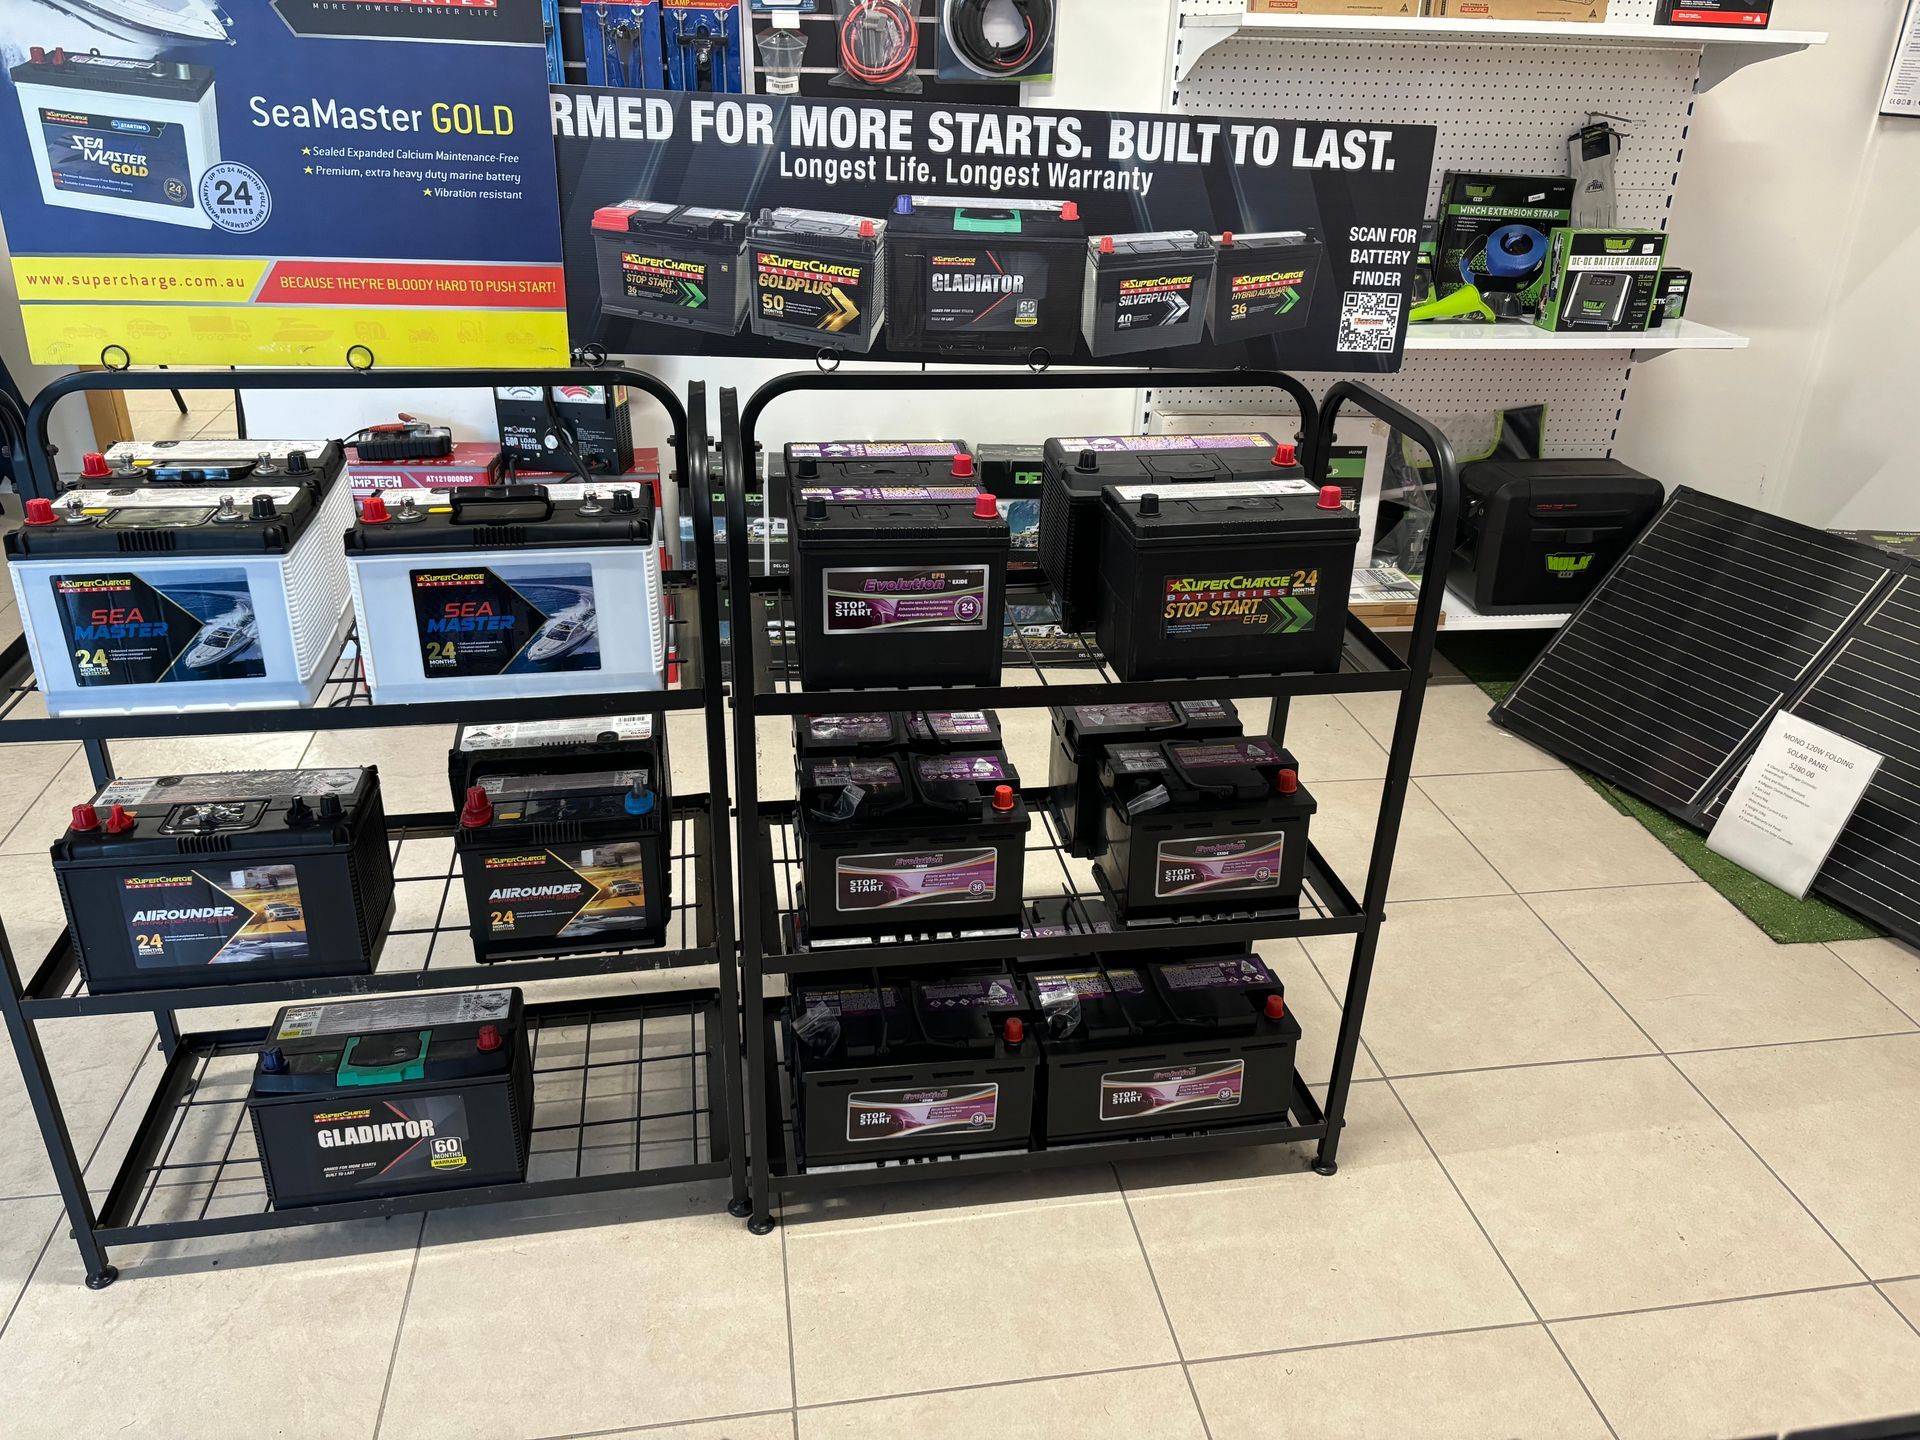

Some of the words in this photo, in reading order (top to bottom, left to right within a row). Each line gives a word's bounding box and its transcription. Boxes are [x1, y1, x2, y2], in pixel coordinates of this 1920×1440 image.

[312, 2, 347, 11] MORE
[356, 4, 405, 13] POWER.
[409, 6, 461, 15] LONGER
[469, 9, 499, 17] LIFE
[249, 95, 423, 132] SeaMaster
[431, 103, 515, 136] GOLD
[120, 122, 147, 131] STARTING
[70, 135, 103, 150] SEA
[691, 100, 774, 145] FOR
[790, 105, 913, 151] MORE
[928, 111, 1092, 159] STARTS.
[1108, 119, 1221, 164] BUILT
[1230, 125, 1280, 167] TO
[1291, 127, 1396, 171] LAST.
[83, 148, 147, 166] MASTER
[313, 146, 345, 157] Sealed
[347, 147, 394, 160] Expanded
[396, 149, 434, 160] Calcium
[436, 150, 520, 163] Maintenance-Free
[111, 163, 149, 177] GOLD
[316, 166, 363, 179] Premium,
[365, 169, 391, 178] extra
[393, 168, 423, 181] heavy
[425, 170, 448, 182] duty
[449, 172, 484, 181] marine
[486, 172, 521, 184] battery
[780, 152, 876, 184] Longest
[885, 155, 937, 183] Life.
[946, 158, 1040, 191] Longest
[1048, 163, 1154, 195] Warranty
[208, 171, 216, 182] UP
[216, 167, 226, 175] TO
[236, 168, 262, 191] MONTHS
[169, 182, 182, 194] 24
[214, 180, 253, 206] 24
[434, 188, 477, 199] Vibration
[479, 190, 523, 200] resistant
[220, 207, 254, 215] MONTHS
[1460, 206, 1486, 214] WINCH
[1488, 208, 1532, 217] EXTENSION
[1533, 209, 1559, 218] STRAP
[1349, 226, 1386, 242] SCAN
[1390, 228, 1417, 244] FOR
[1350, 249, 1411, 265] BATTERY
[1572, 257, 1592, 266] DC-DC
[1594, 257, 1625, 266] BATTERY
[1626, 257, 1657, 266] CHARGER
[623, 263, 704, 281] BATTERIES
[758, 266, 858, 286] BATTERIES
[1352, 271, 1402, 286] FINDER
[26, 275, 246, 291] www.supercharge.com.au
[280, 277, 334, 289] BECAUSE
[335, 278, 385, 290] THEY'RE
[387, 278, 432, 291] BLOODY
[435, 280, 466, 291] HARD
[468, 281, 484, 292] TO
[485, 281, 516, 292] PUSH
[518, 281, 556, 293] START!
[626, 273, 646, 286] STOP
[647, 276, 673, 289] START
[758, 274, 833, 296] GOLDPLUS
[931, 273, 1024, 293] GLADIATOR
[1232, 279, 1302, 291] BATTERIES
[627, 286, 638, 294] 36
[1120, 284, 1191, 294] BATTERIES
[1232, 290, 1257, 301] HYBRID
[762, 294, 784, 310] 50
[1118, 291, 1177, 307] SILVERPLUS
[1019, 301, 1036, 313] 60
[1231, 303, 1247, 315] 36
[1117, 313, 1132, 324] 40
[504, 426, 536, 434] PROJECTA
[426, 475, 474, 483] AT121000DSP
[1547, 555, 1593, 571] HULK
[64, 579, 131, 588] SUPERCHARGE
[424, 573, 485, 582] SUPERCHARGE
[863, 577, 945, 592] Evolution
[1181, 575, 1291, 592] SUPERCHARGE
[1292, 569, 1318, 588] 24
[1167, 588, 1288, 602] BATTERIES
[444, 601, 494, 618] SEA
[835, 601, 866, 609] STOP
[961, 603, 974, 611] 24
[1164, 601, 1208, 619] STOP
[1209, 598, 1263, 616] START
[91, 607, 145, 625] SEA
[835, 608, 872, 617] START
[1242, 614, 1269, 625] EFB
[427, 615, 516, 633] MASTER
[74, 622, 169, 641] MASTER
[426, 641, 457, 660] 24
[75, 648, 108, 668] 24
[1783, 732, 1806, 748] MONO
[1805, 743, 1826, 756] 120W
[1824, 751, 1855, 770] FOLDING
[1786, 747, 1808, 762] SOLAR
[1808, 757, 1830, 772] PANEL
[1788, 762, 1816, 779] $280.00
[1194, 842, 1246, 854] Evolution
[486, 860, 546, 868] BATTERIES
[492, 855, 547, 864] SUPERCHARGE
[894, 856, 943, 866] Evolution
[1165, 868, 1191, 876] STOP
[1165, 873, 1196, 882] START
[1258, 869, 1268, 878] 36
[133, 875, 193, 884] SUPERCHARGE
[849, 885, 883, 893] START
[972, 883, 982, 891] 36
[491, 910, 515, 925] 24
[135, 933, 164, 948] 24
[1112, 1096, 1142, 1105] START
[860, 1117, 891, 1125] START
[974, 1114, 983, 1122] 36
[318, 1119, 435, 1148] GLADIATOR
[435, 1139, 458, 1152] 60
[433, 1158, 464, 1166] WARRANTY
